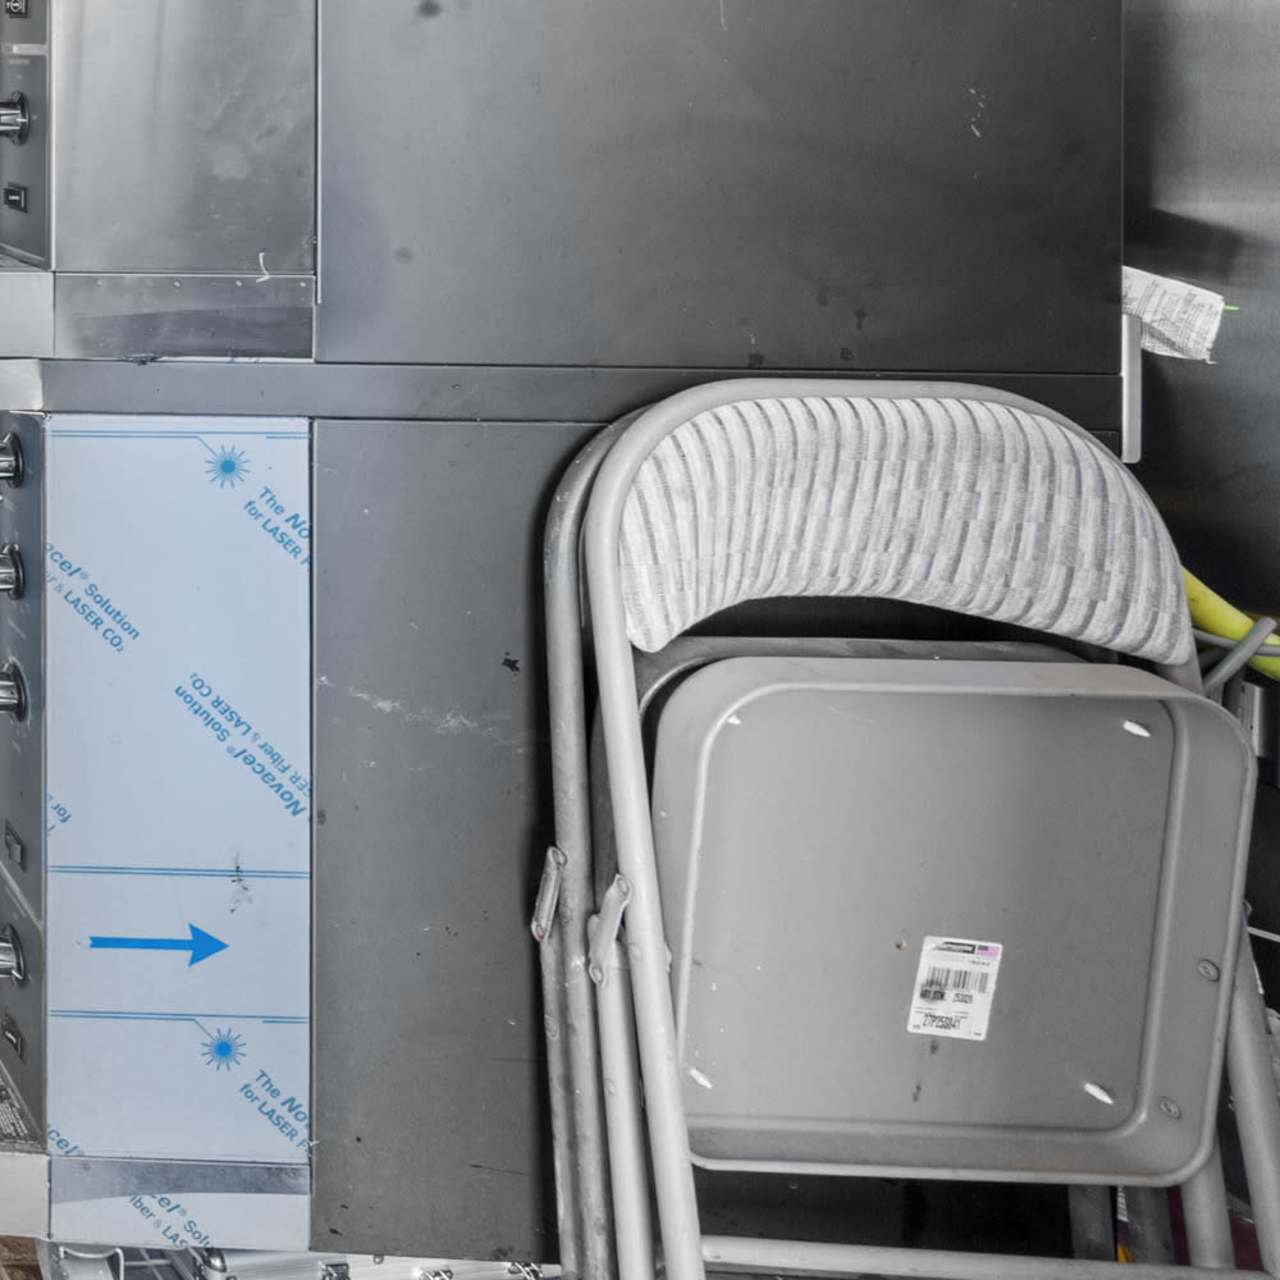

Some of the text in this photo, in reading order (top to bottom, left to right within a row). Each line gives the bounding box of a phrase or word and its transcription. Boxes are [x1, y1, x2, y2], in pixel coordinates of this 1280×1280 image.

[260, 486, 285, 515] The
[243, 500, 264, 521] for
[262, 518, 302, 559] LASER
[64, 590, 104, 631] LASER
[84, 583, 140, 641] Solution
[174, 685, 231, 742] Solution
[211, 695, 252, 736] LASER
[259, 741, 291, 774] Fiber
[50, 803, 72, 823] for
[239, 1082, 260, 1103] for
[258, 1100, 299, 1141] LASER
[255, 1068, 309, 1126] The No
